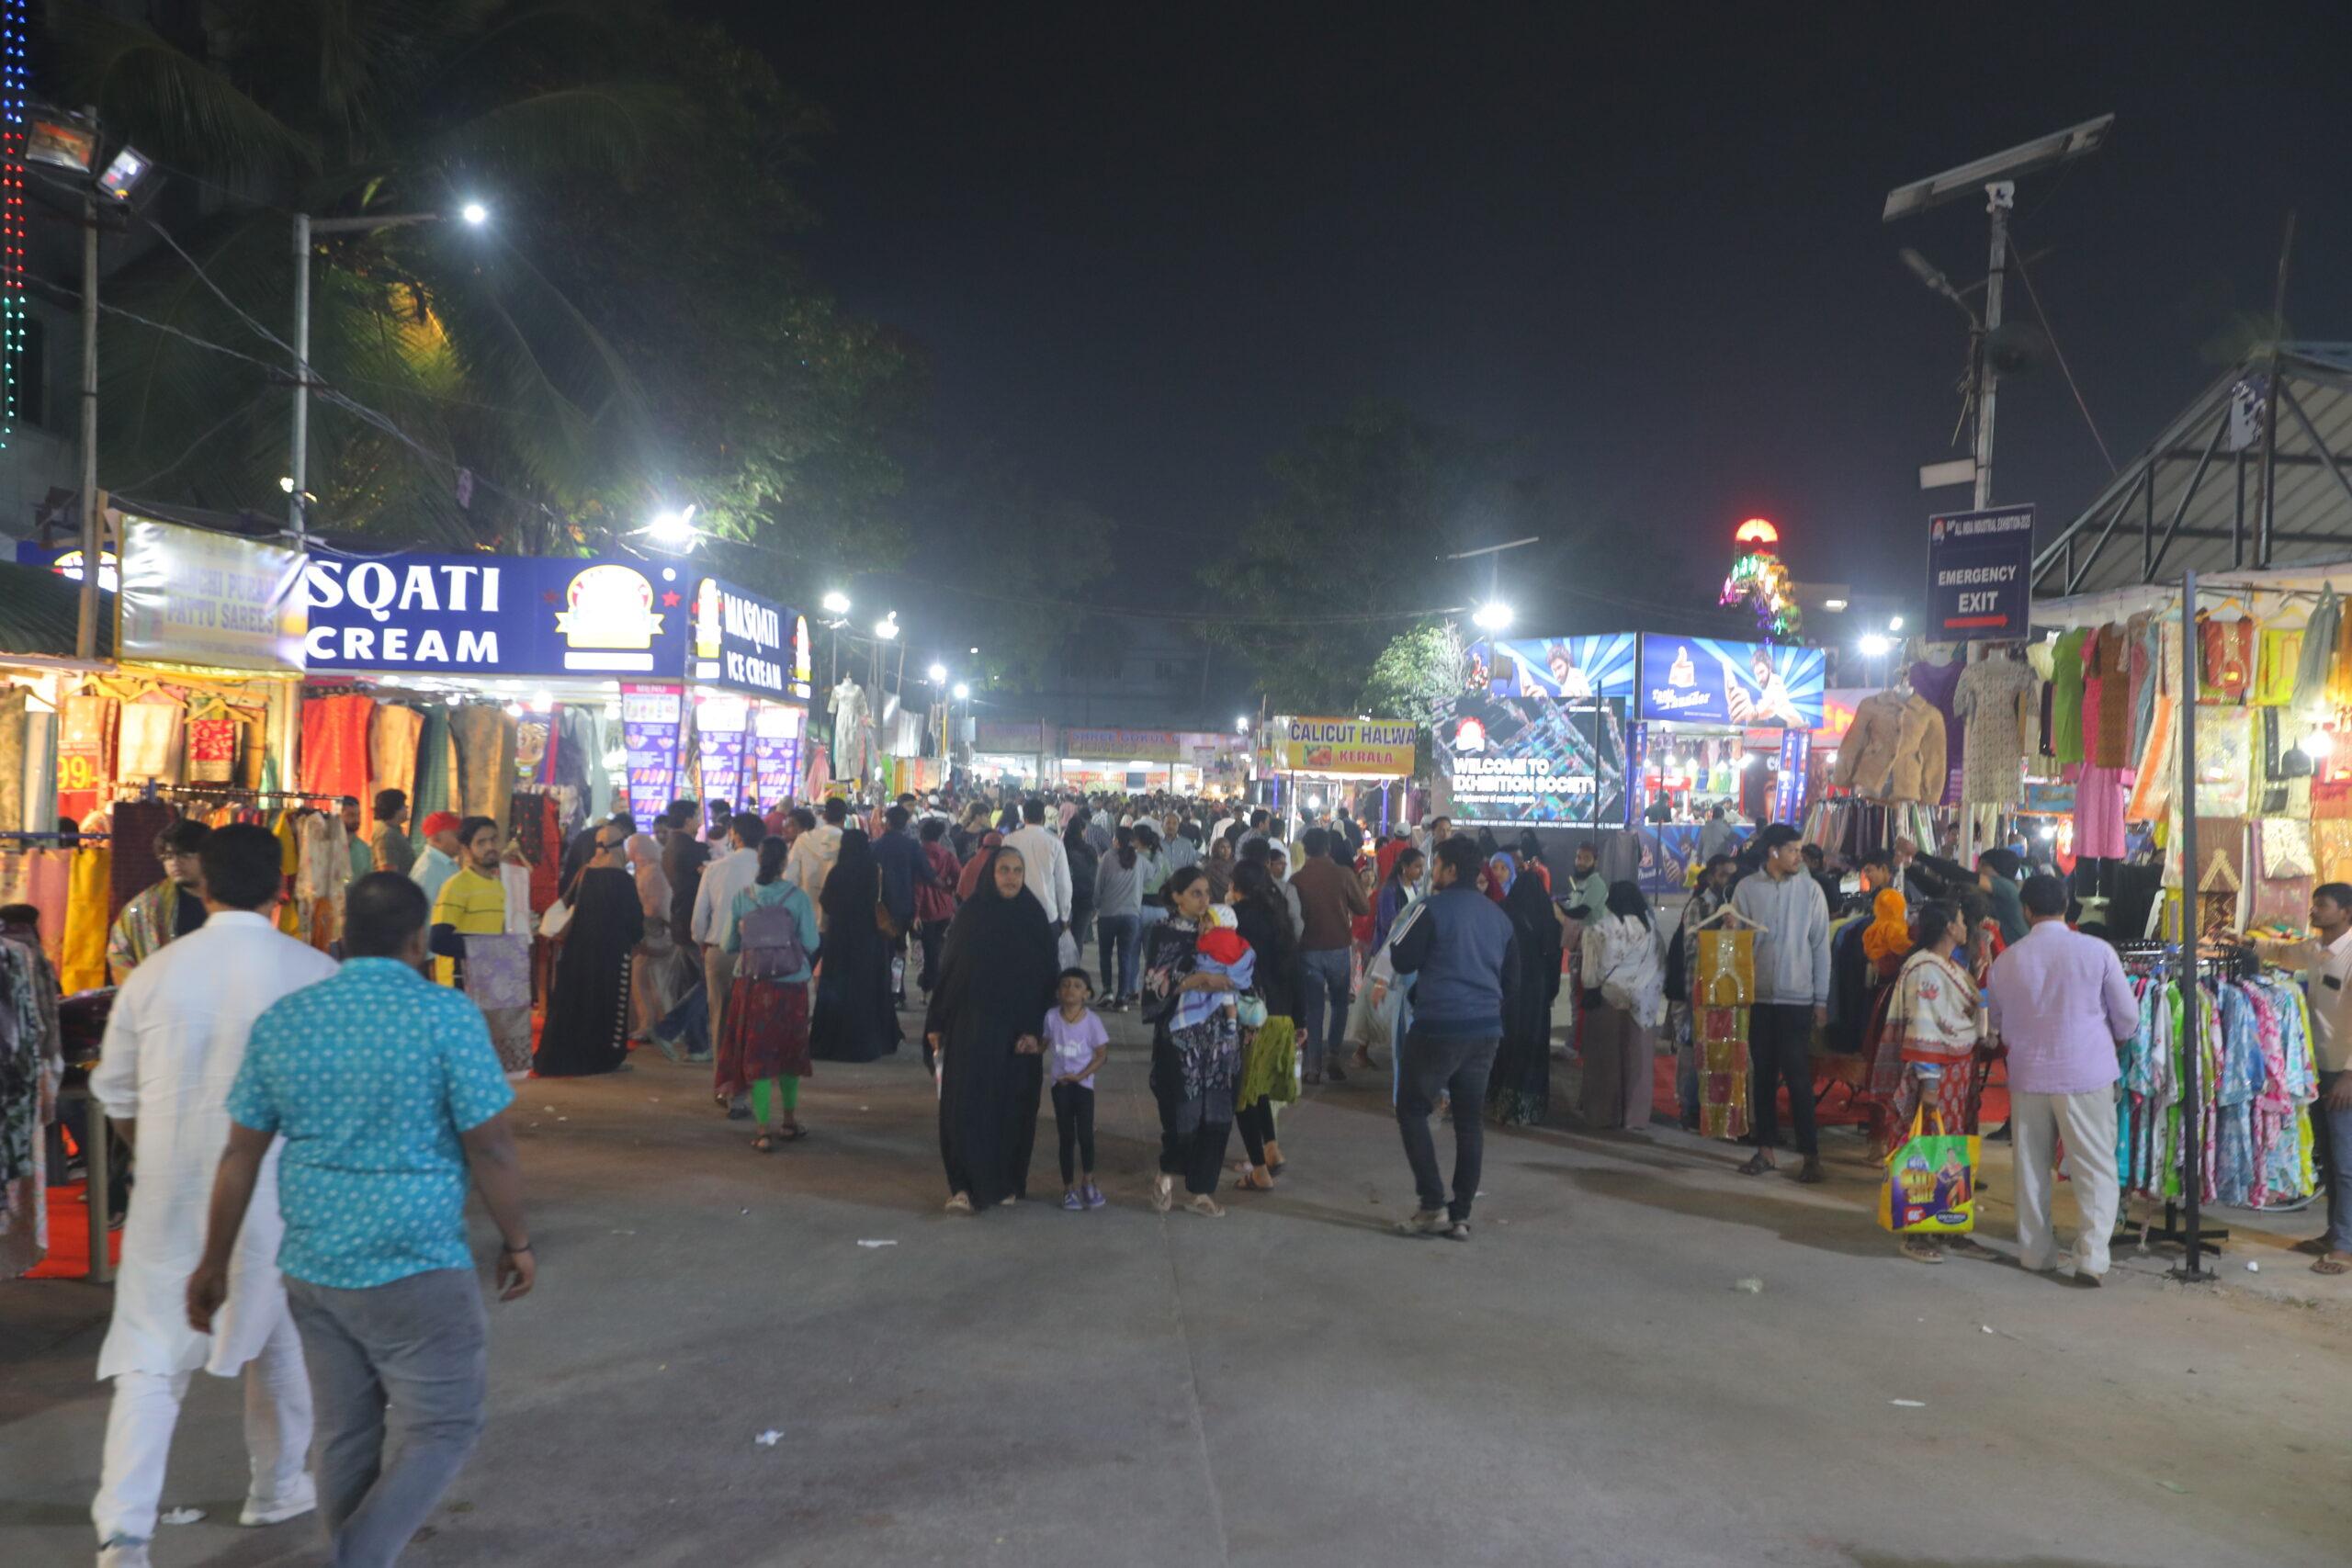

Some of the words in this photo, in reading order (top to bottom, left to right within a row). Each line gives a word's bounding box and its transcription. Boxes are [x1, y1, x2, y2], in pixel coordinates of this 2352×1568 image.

[1939, 565, 2017, 586] EMERGENCY
[308, 560, 500, 622] SQATI
[1958, 591, 1998, 614] EXIT
[167, 595, 217, 628] PATTU
[221, 603, 274, 634] SAREES
[724, 592, 779, 654] MASQATI
[304, 626, 499, 663] CREAM
[727, 650, 745, 682] ICE
[746, 656, 782, 691] CREAM
[1291, 721, 1355, 743] CALICUT
[1361, 726, 1416, 746] HALWA
[1340, 750, 1393, 764] KERALA
[1453, 757, 1527, 775] WELCOME
[1527, 758, 1550, 775] TO
[1453, 775, 1534, 793] EXHIBITION
[1535, 776, 1596, 794] SOCIETY
